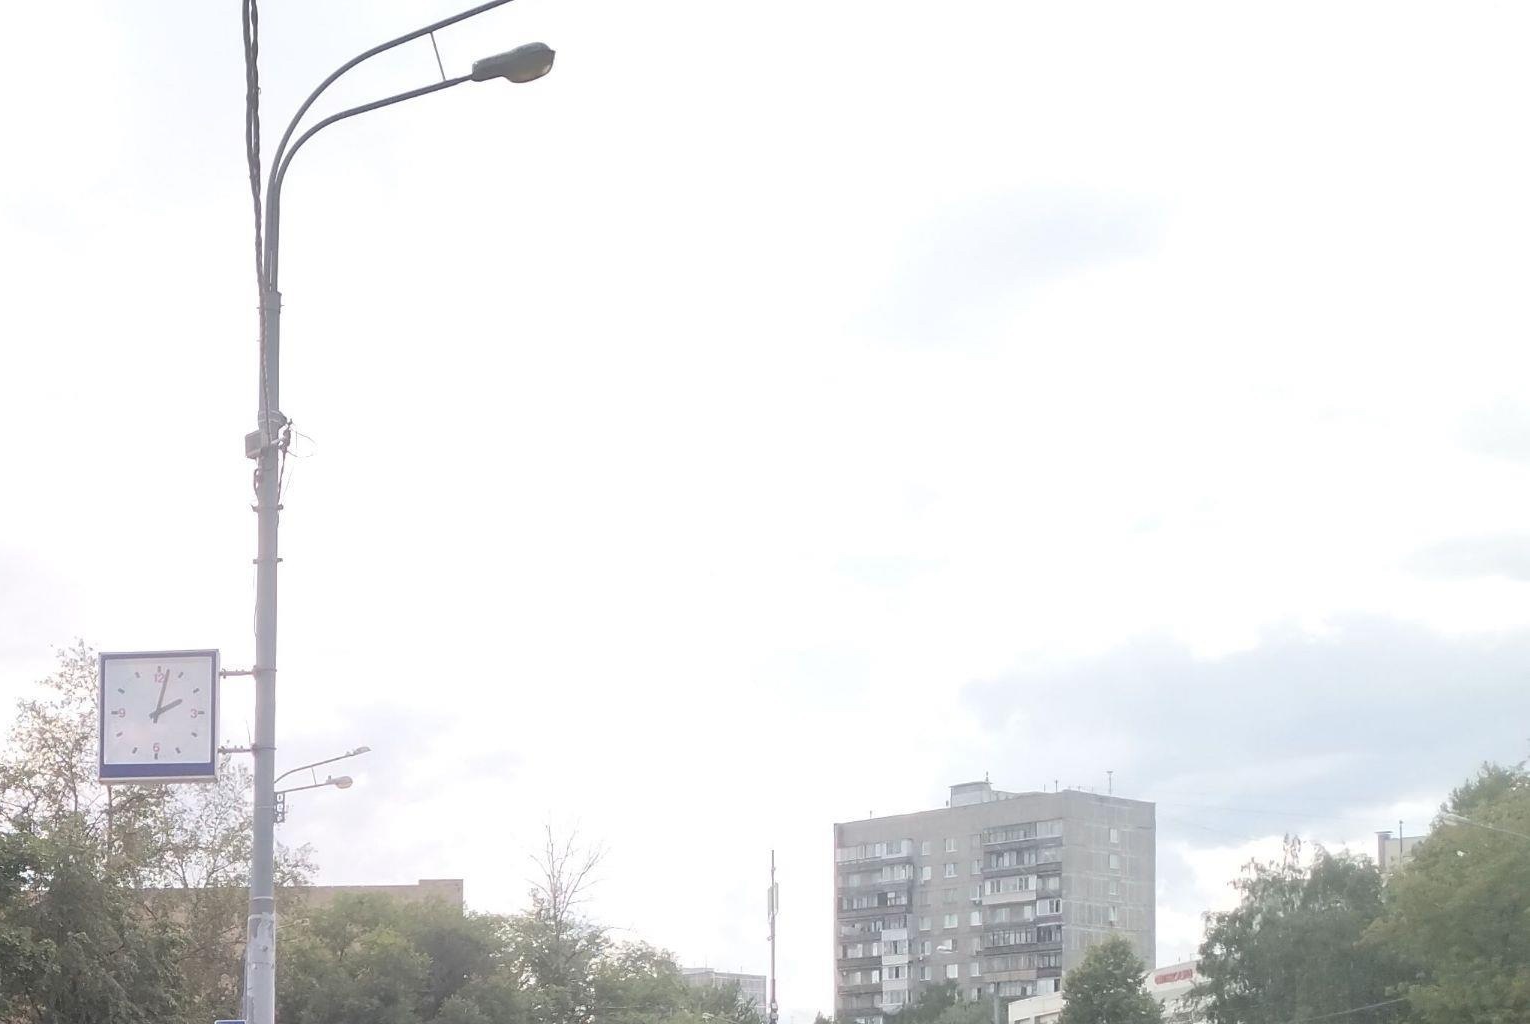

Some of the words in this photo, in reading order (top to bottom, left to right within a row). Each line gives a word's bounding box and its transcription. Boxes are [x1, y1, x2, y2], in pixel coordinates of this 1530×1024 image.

[154, 673, 165, 683] 12
[119, 708, 126, 718] 9
[190, 708, 198, 719] 3
